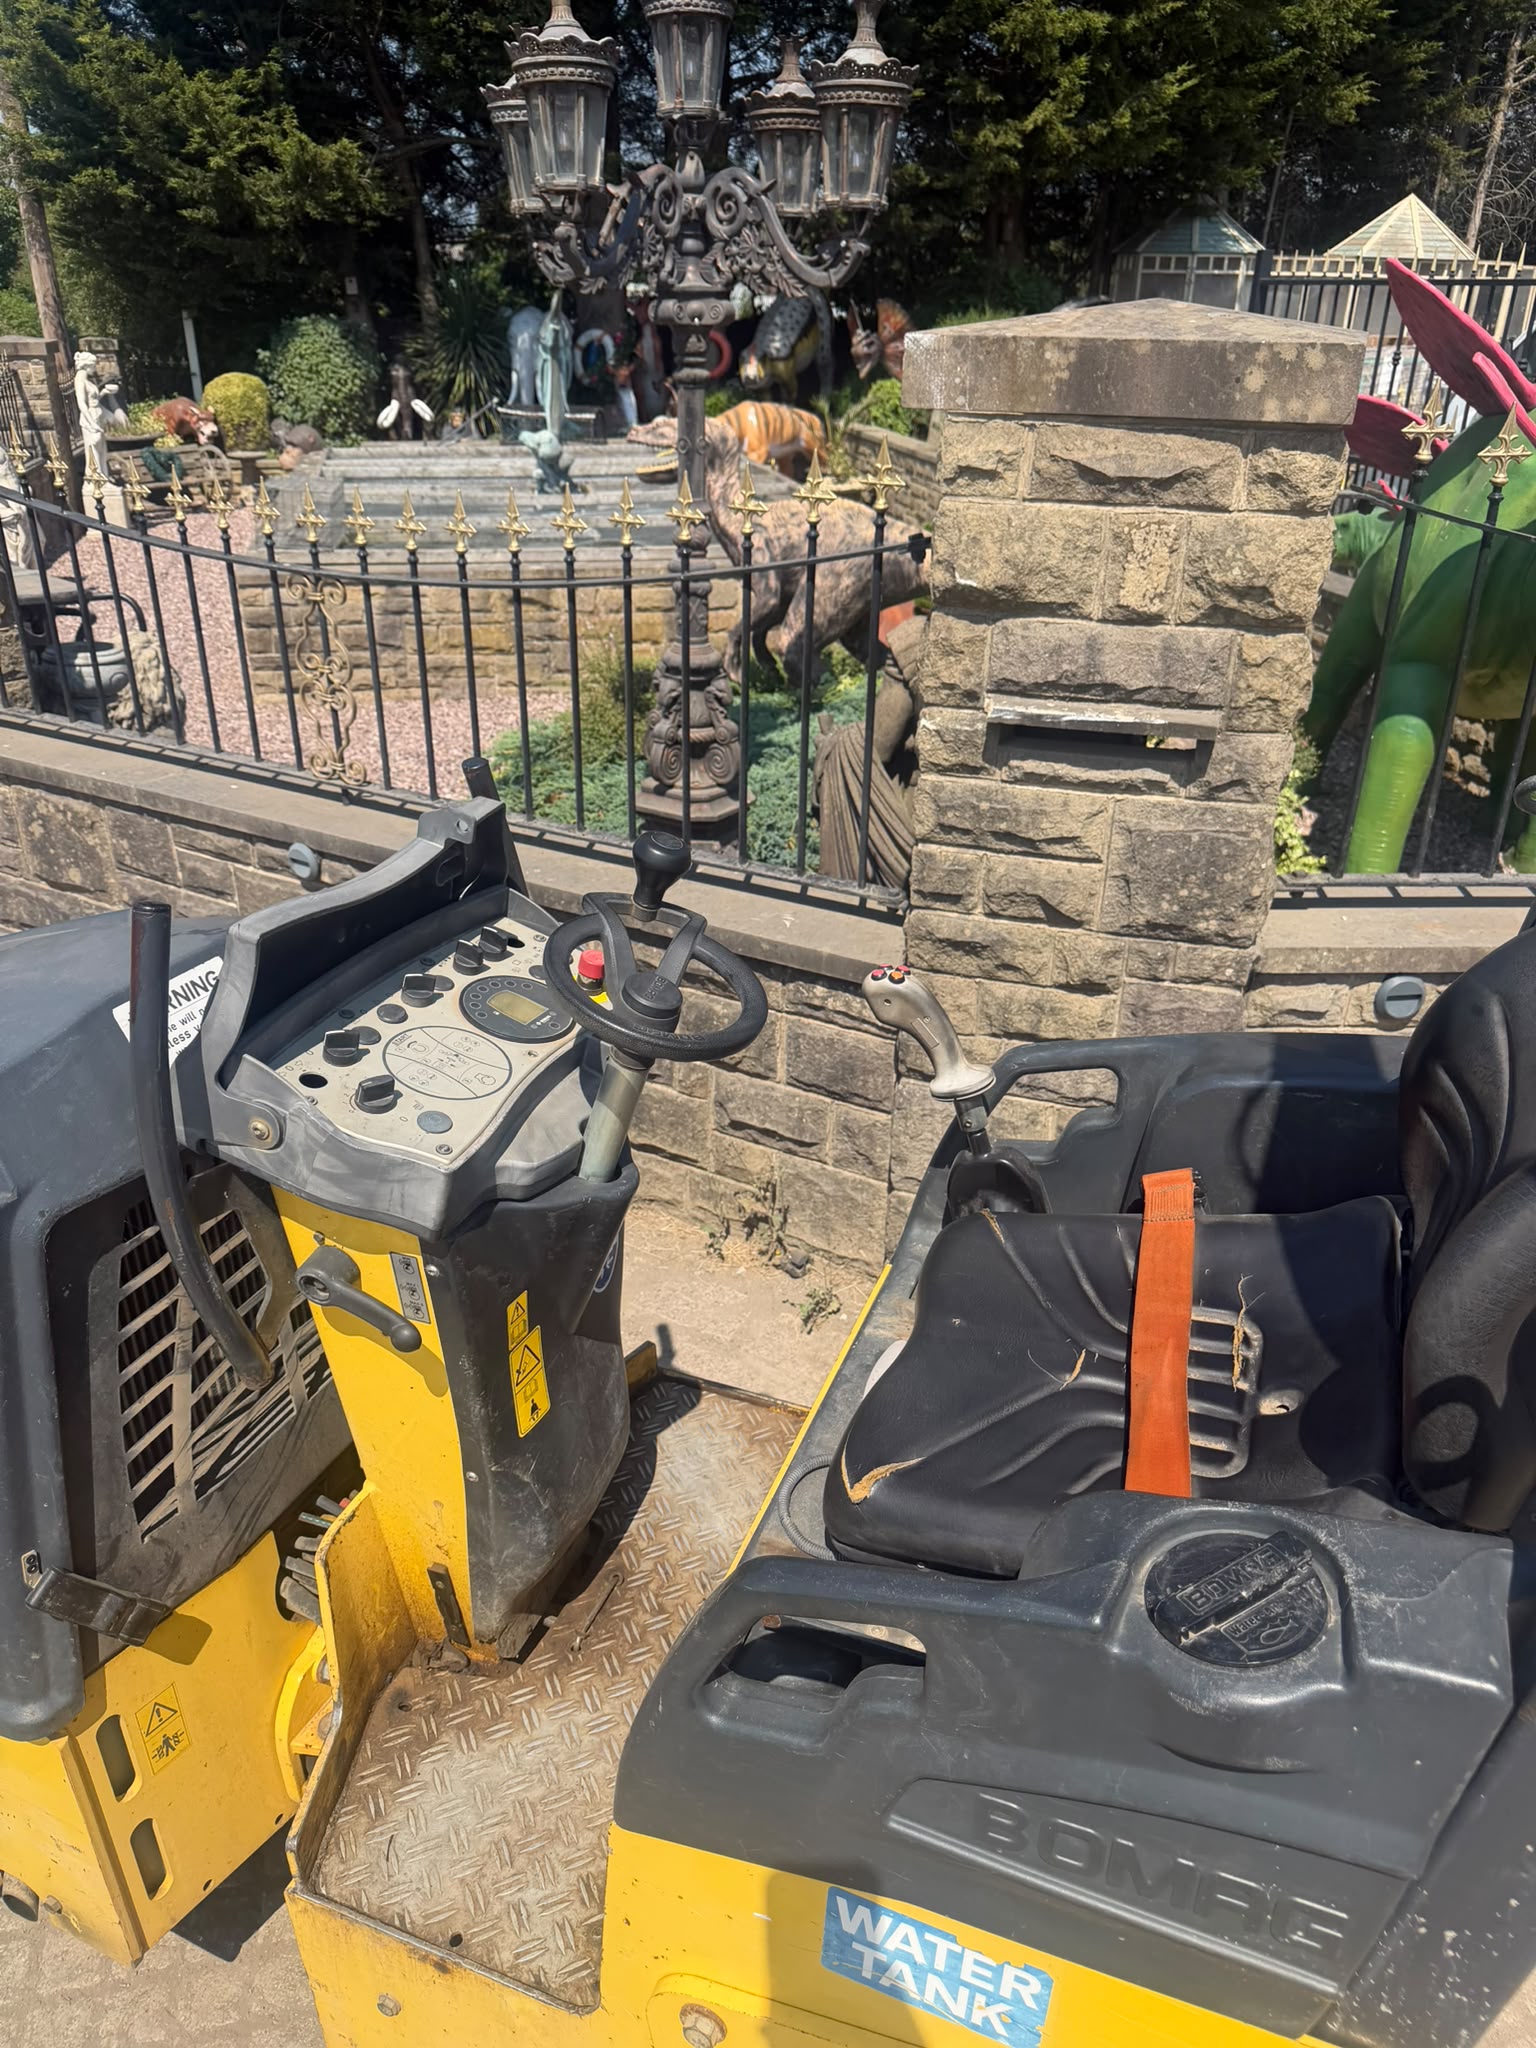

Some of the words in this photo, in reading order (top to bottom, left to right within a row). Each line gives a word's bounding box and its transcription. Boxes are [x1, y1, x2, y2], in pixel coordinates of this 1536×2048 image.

[168, 970, 219, 1011] RNING
[179, 1010, 197, 1026] will
[168, 1030, 192, 1049] less
[978, 1792, 1349, 1958] BOMAG
[836, 1895, 1042, 2011] WATER
[852, 1941, 1014, 2038] TANK
